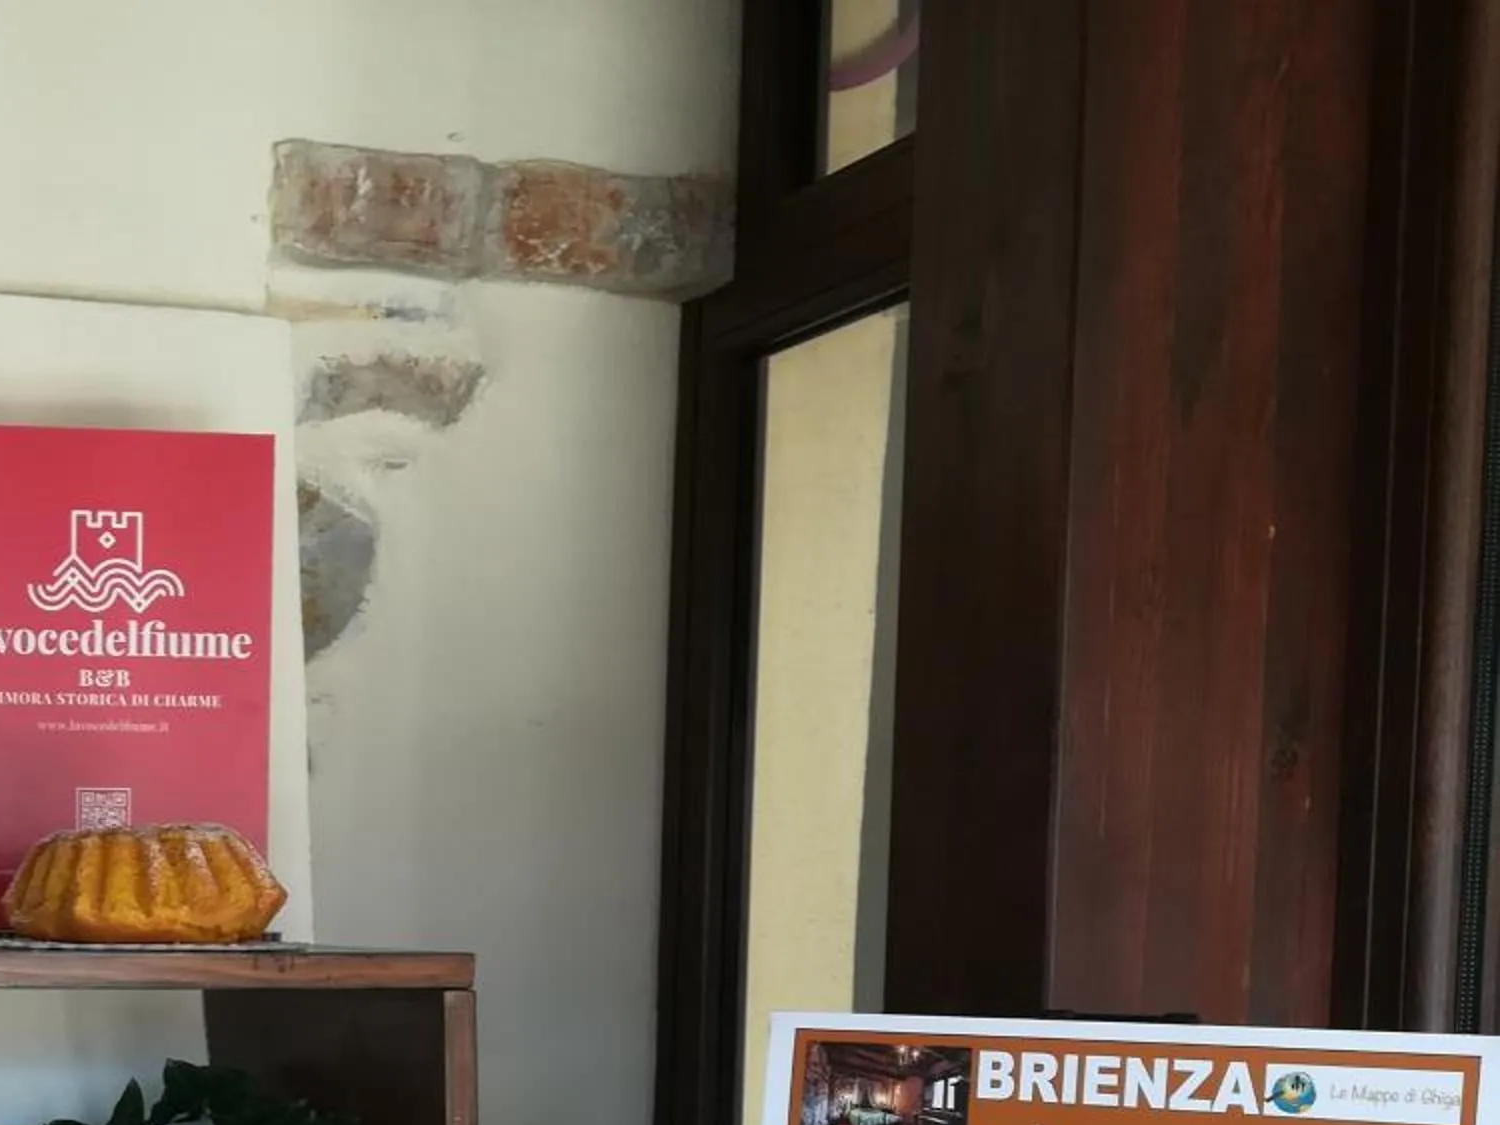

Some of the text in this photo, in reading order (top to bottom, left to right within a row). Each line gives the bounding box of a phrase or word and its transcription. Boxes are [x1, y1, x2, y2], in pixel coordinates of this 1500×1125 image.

[79, 669, 131, 688] B&B
[56, 693, 128, 707] STORICA
[132, 694, 149, 707] DI
[154, 694, 223, 709] CHARME
[976, 1050, 1262, 1115] BRIENZA
[1329, 1084, 1347, 1100] Le
[1351, 1084, 1400, 1107] Mappe
